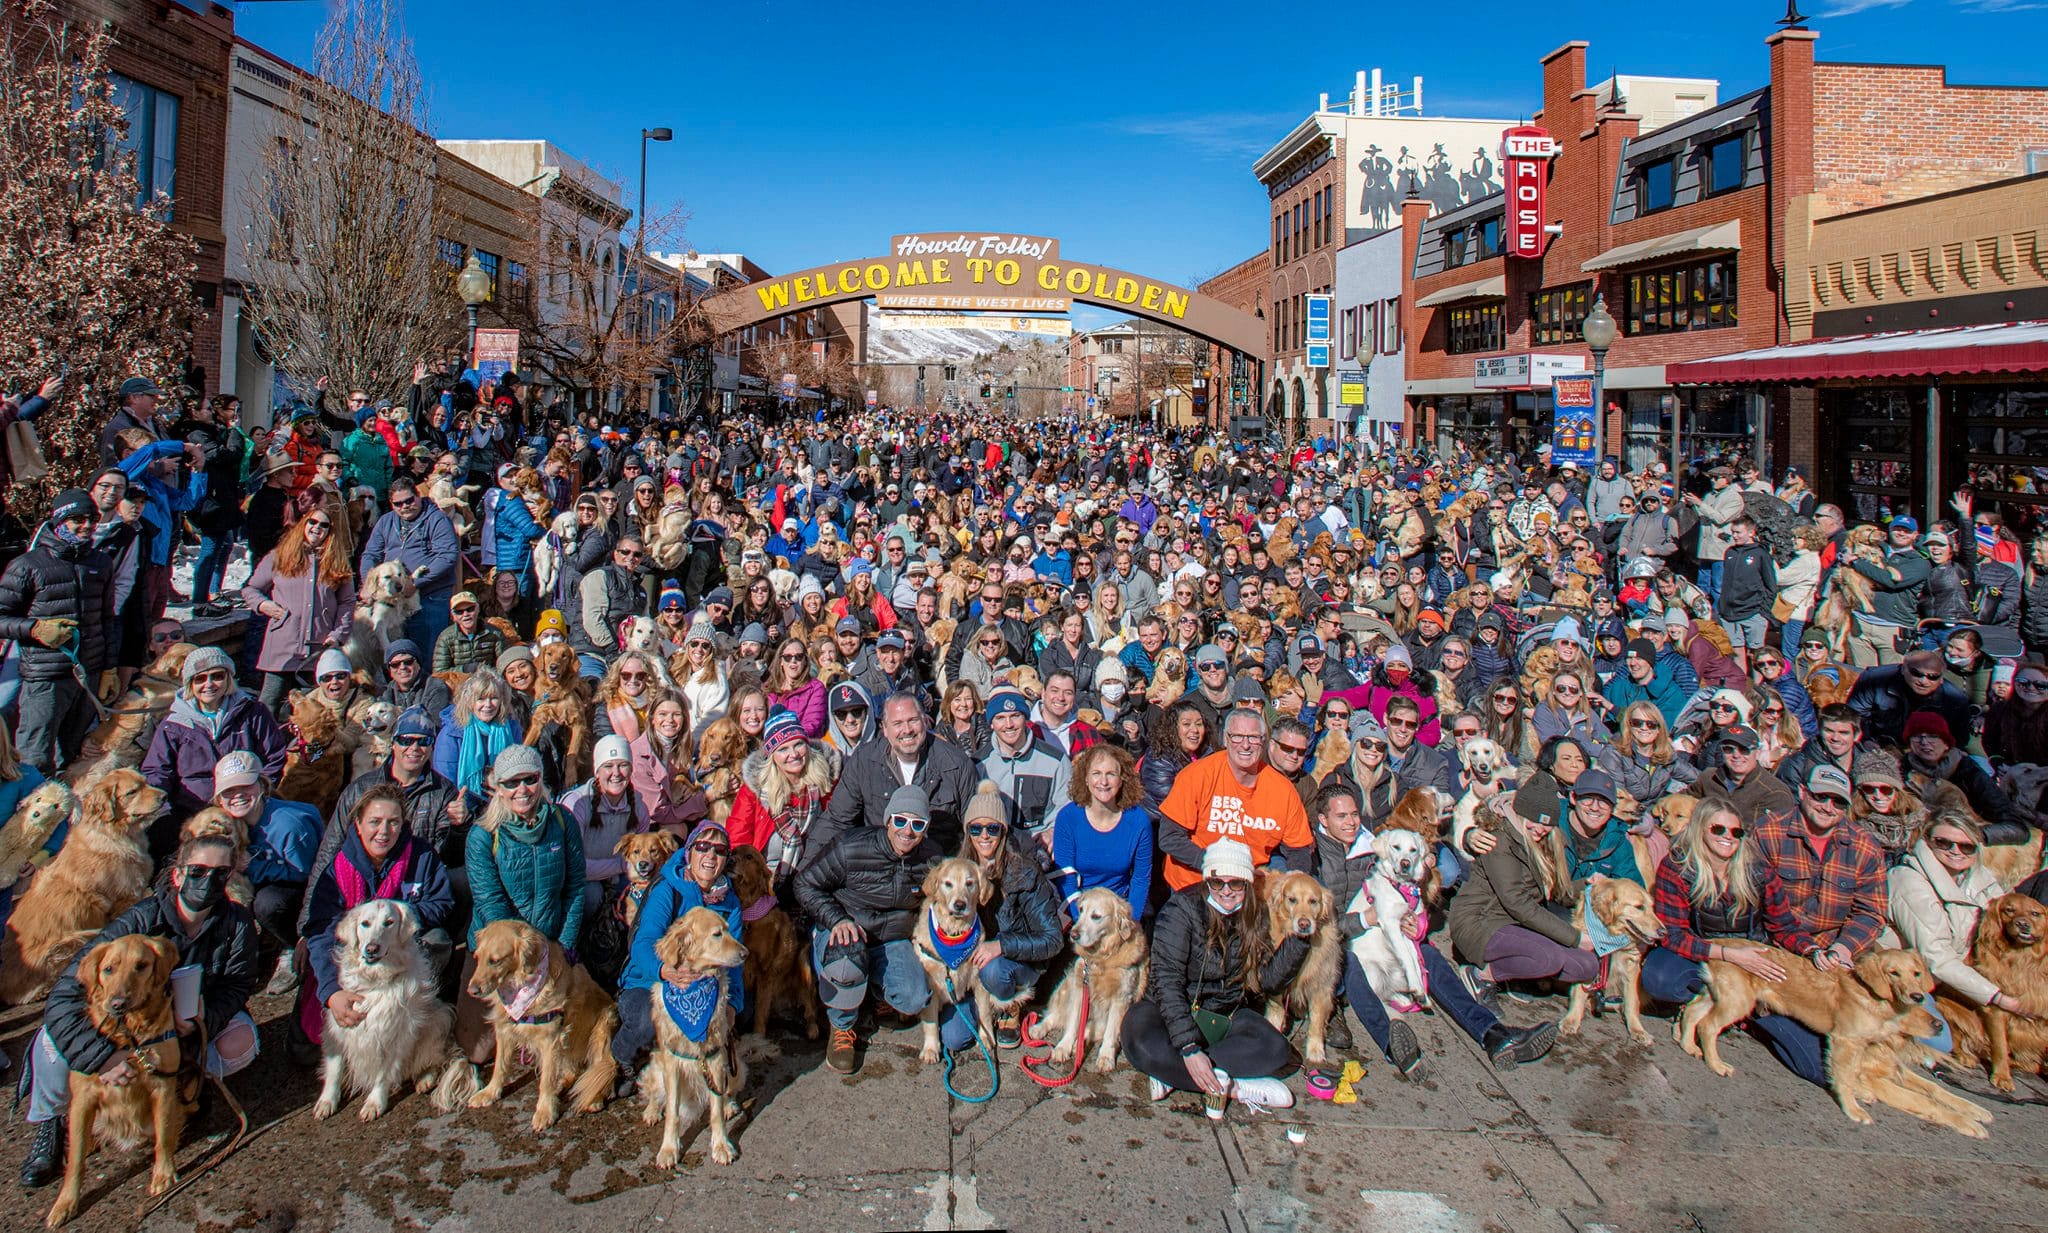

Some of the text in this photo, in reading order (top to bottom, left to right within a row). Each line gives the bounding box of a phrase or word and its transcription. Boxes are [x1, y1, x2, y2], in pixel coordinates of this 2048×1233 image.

[1512, 141, 1551, 152] THE
[1518, 162, 1538, 249] ROSE
[897, 235, 1052, 260] Howdy Folks!
[757, 258, 1190, 319] WELCOME TO GOLDEN
[884, 297, 1065, 309] WHERE THE WEST LIVES
[1242, 814, 1281, 831] DAD.
